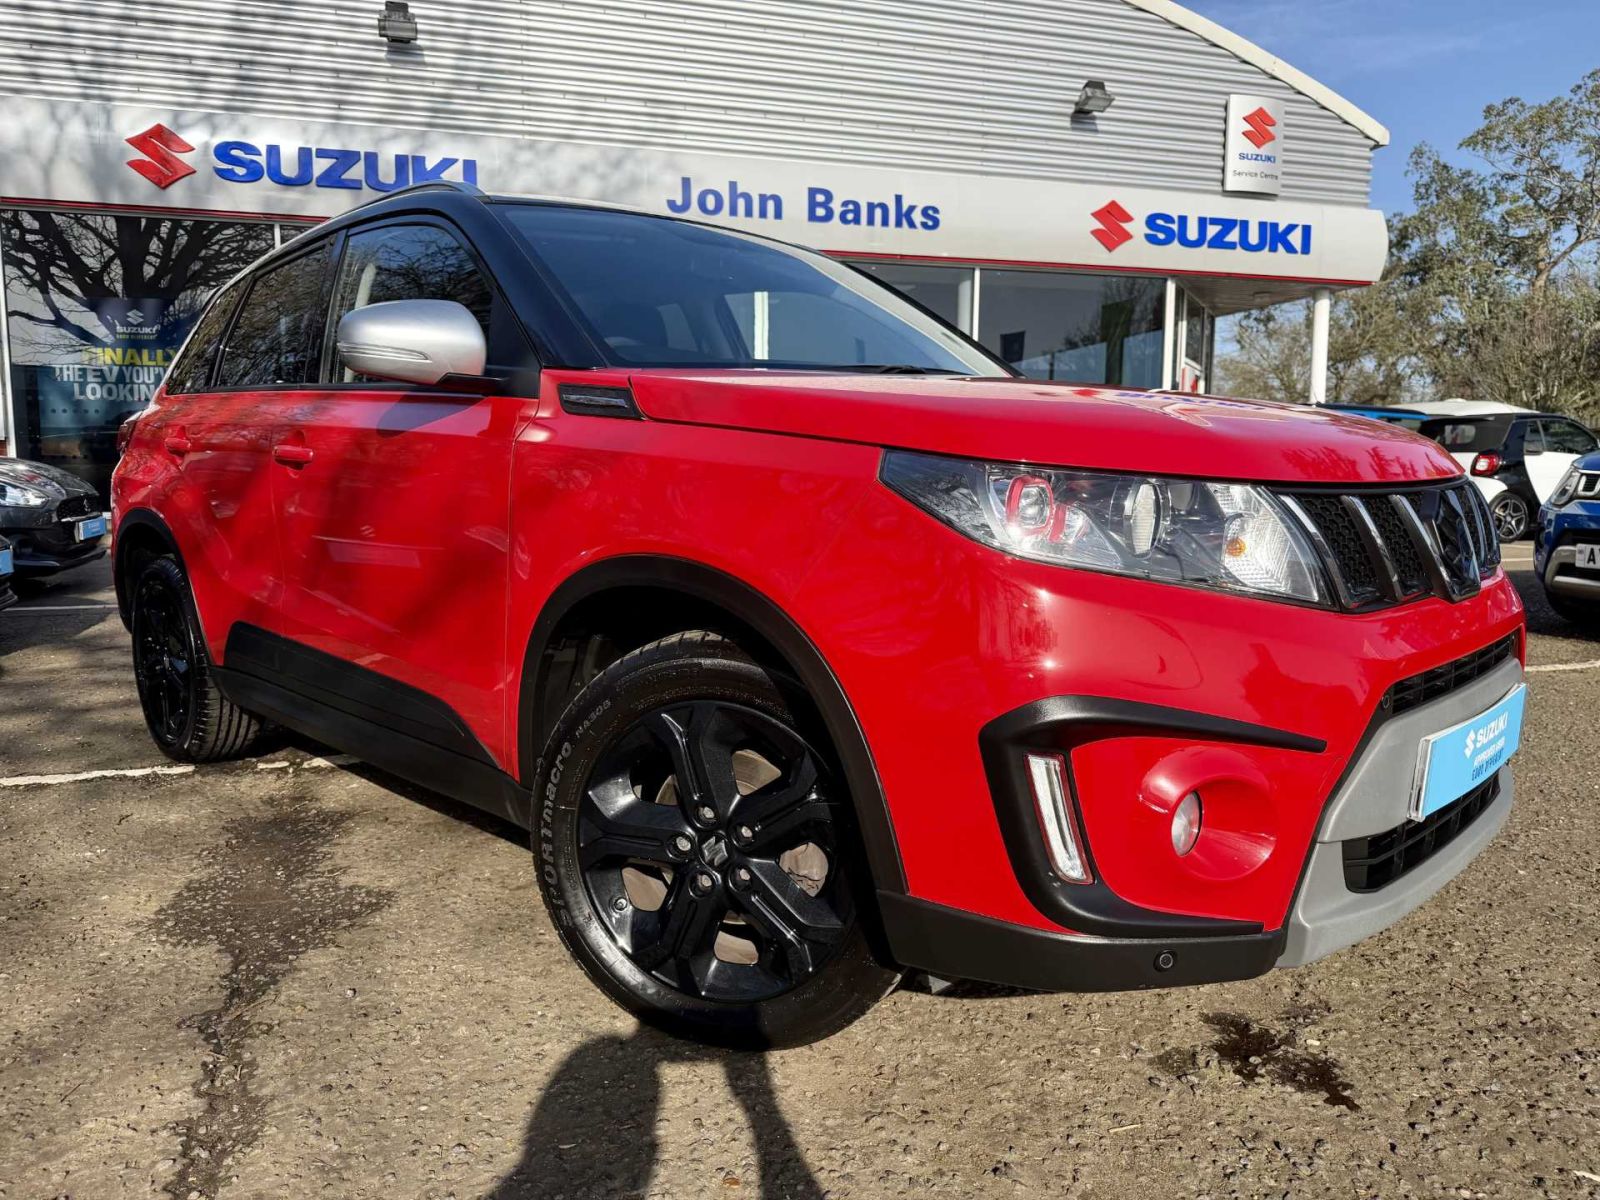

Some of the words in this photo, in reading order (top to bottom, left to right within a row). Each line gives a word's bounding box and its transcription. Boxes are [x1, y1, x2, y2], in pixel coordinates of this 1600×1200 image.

[213, 140, 478, 193] SUZUKI
[1238, 152, 1276, 164] SUZUKI
[1232, 169, 1258, 178] Service
[1259, 171, 1279, 181] Centre
[666, 176, 783, 220] John
[807, 186, 940, 231] Banks
[1144, 212, 1312, 255] SUZUKI
[115, 325, 157, 334] SUZUKI
[87, 366, 120, 383] EV
[1475, 711, 1509, 749] SUZUKI
